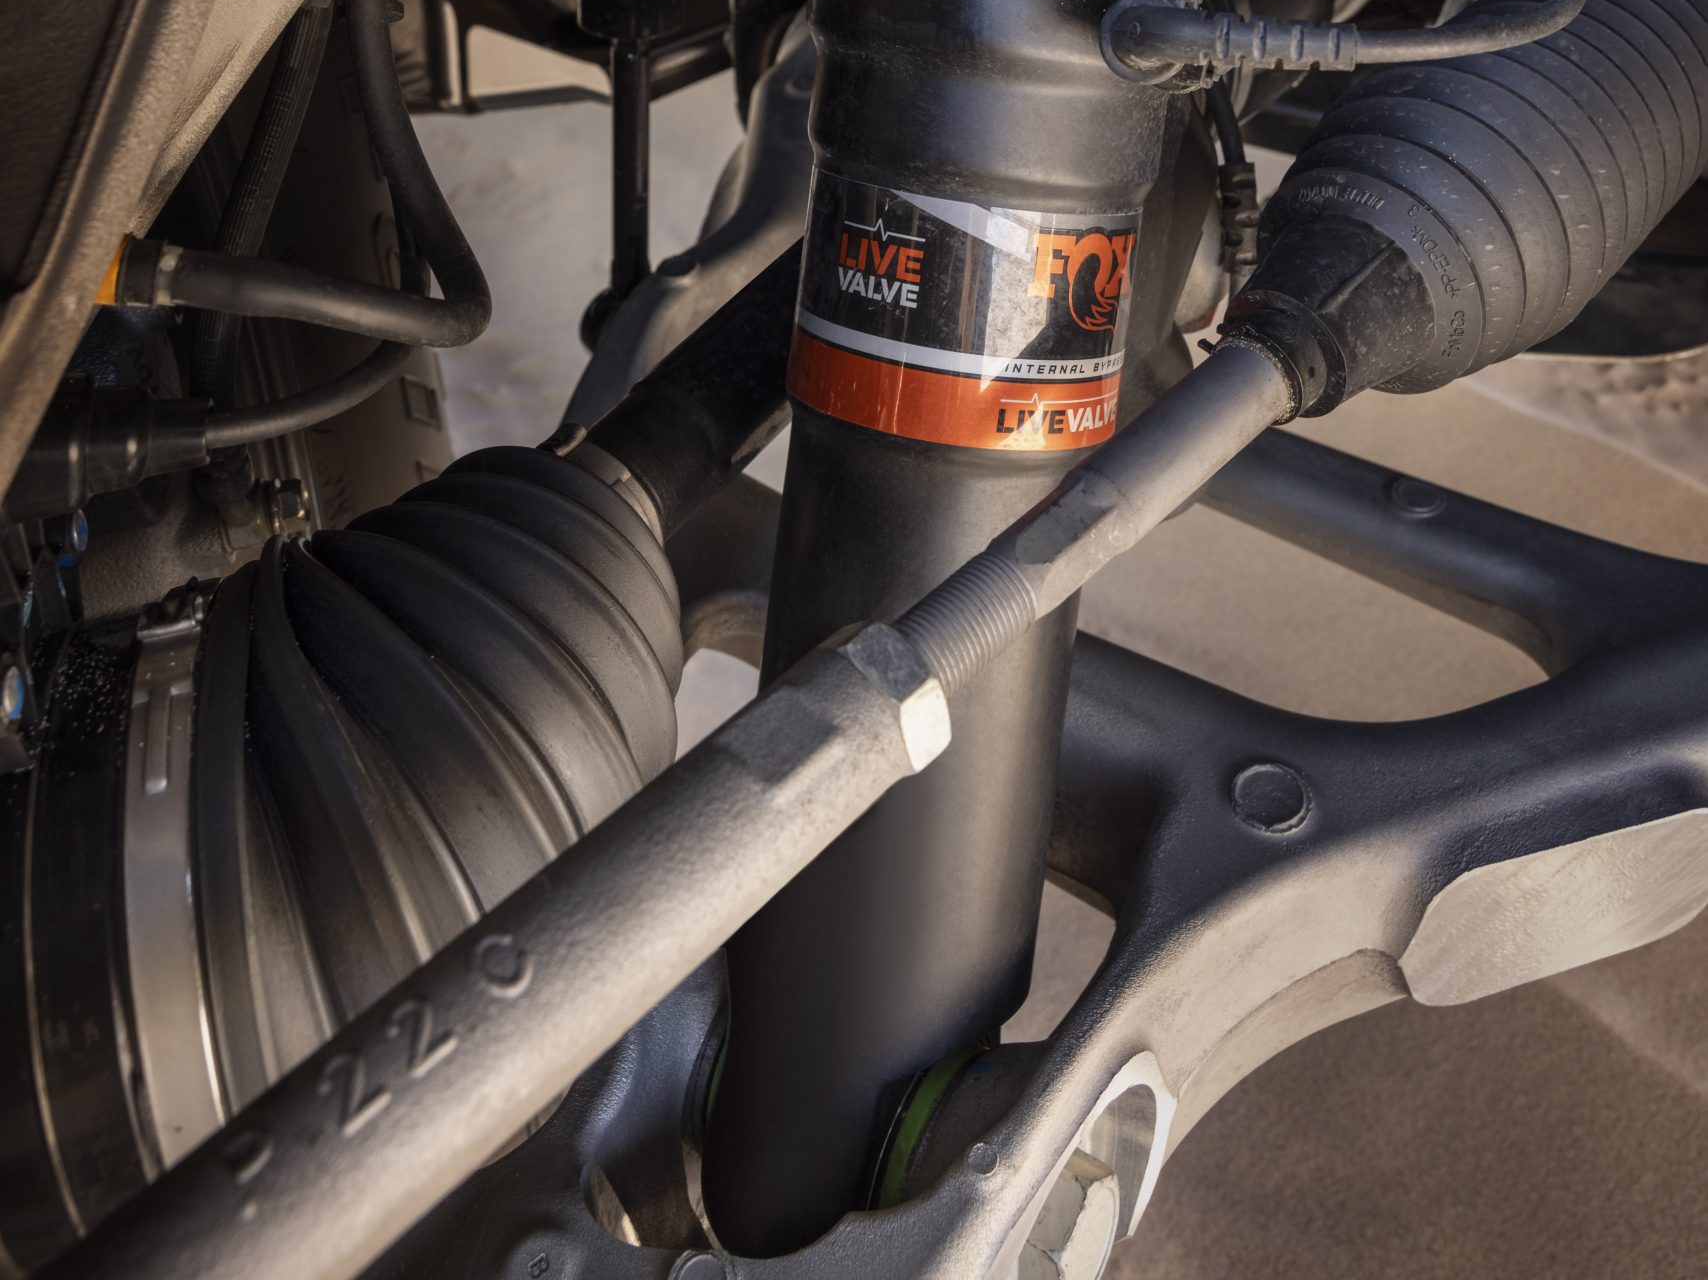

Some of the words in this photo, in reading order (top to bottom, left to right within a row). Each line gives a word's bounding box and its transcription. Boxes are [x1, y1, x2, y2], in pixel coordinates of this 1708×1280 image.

[839, 233, 924, 283] LIVE
[838, 266, 920, 309] VALVE
[1027, 232, 1136, 332] FOX
[1004, 363, 1085, 375] INTERNAL
